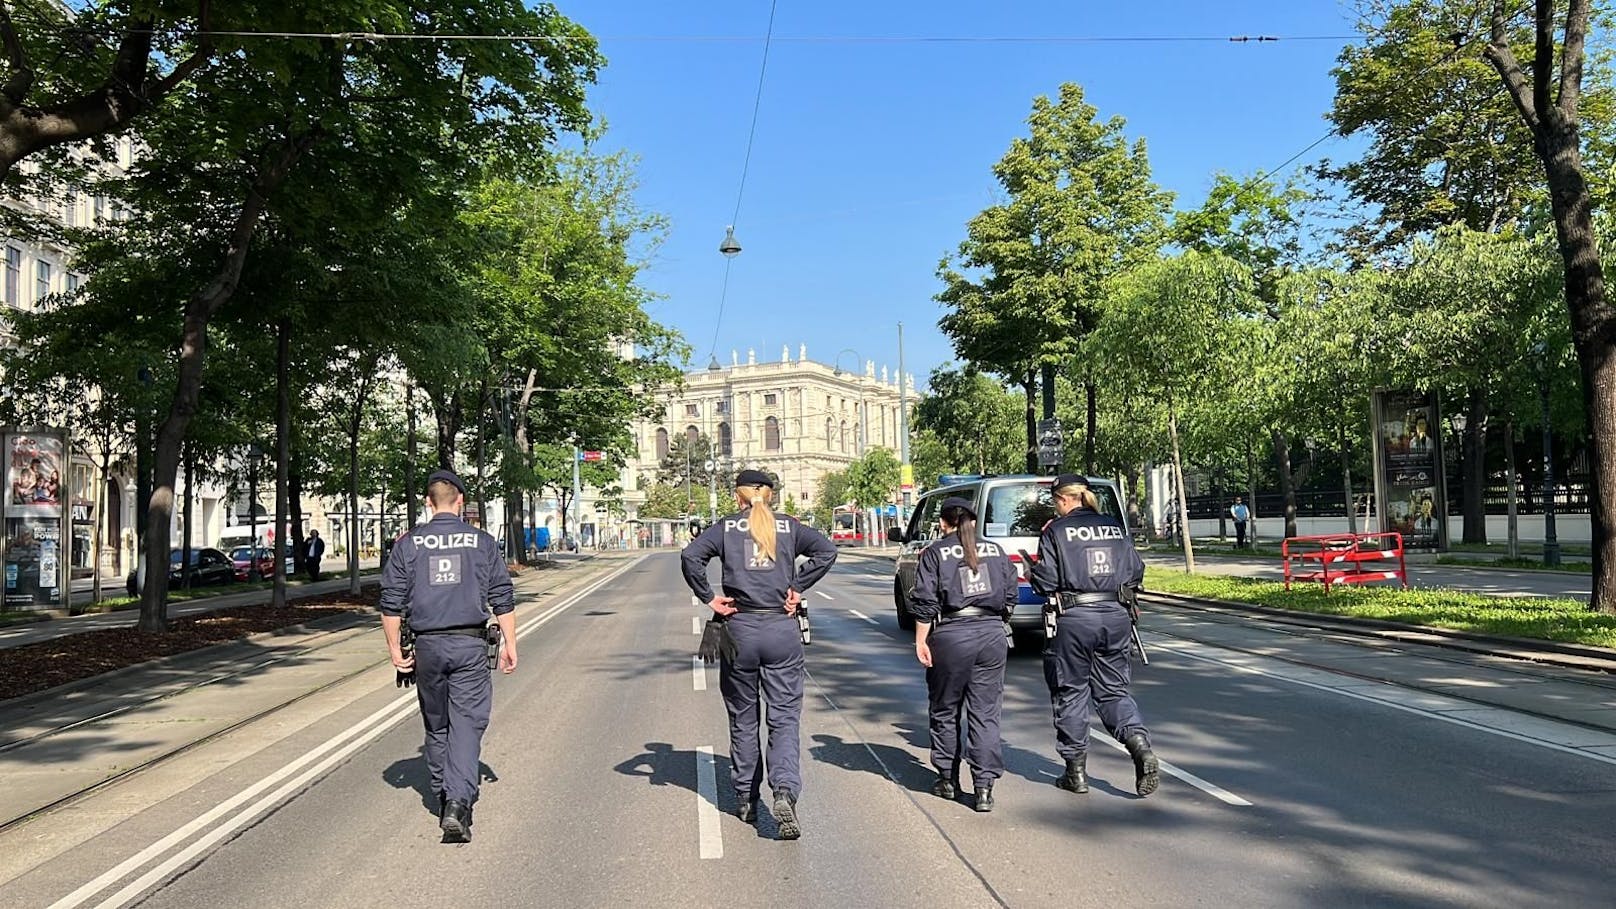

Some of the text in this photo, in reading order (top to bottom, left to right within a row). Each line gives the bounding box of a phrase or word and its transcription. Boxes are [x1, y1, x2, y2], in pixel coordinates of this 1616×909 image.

[725, 518, 791, 533] POEI
[1065, 525, 1124, 542] POLIZEI
[413, 533, 479, 550] POLIZEI
[939, 542, 1001, 561] POZEI
[1095, 551, 1106, 563] D
[438, 558, 451, 572] D
[1092, 564, 1110, 574] 212
[435, 572, 455, 583] 212
[967, 582, 987, 594] 212
